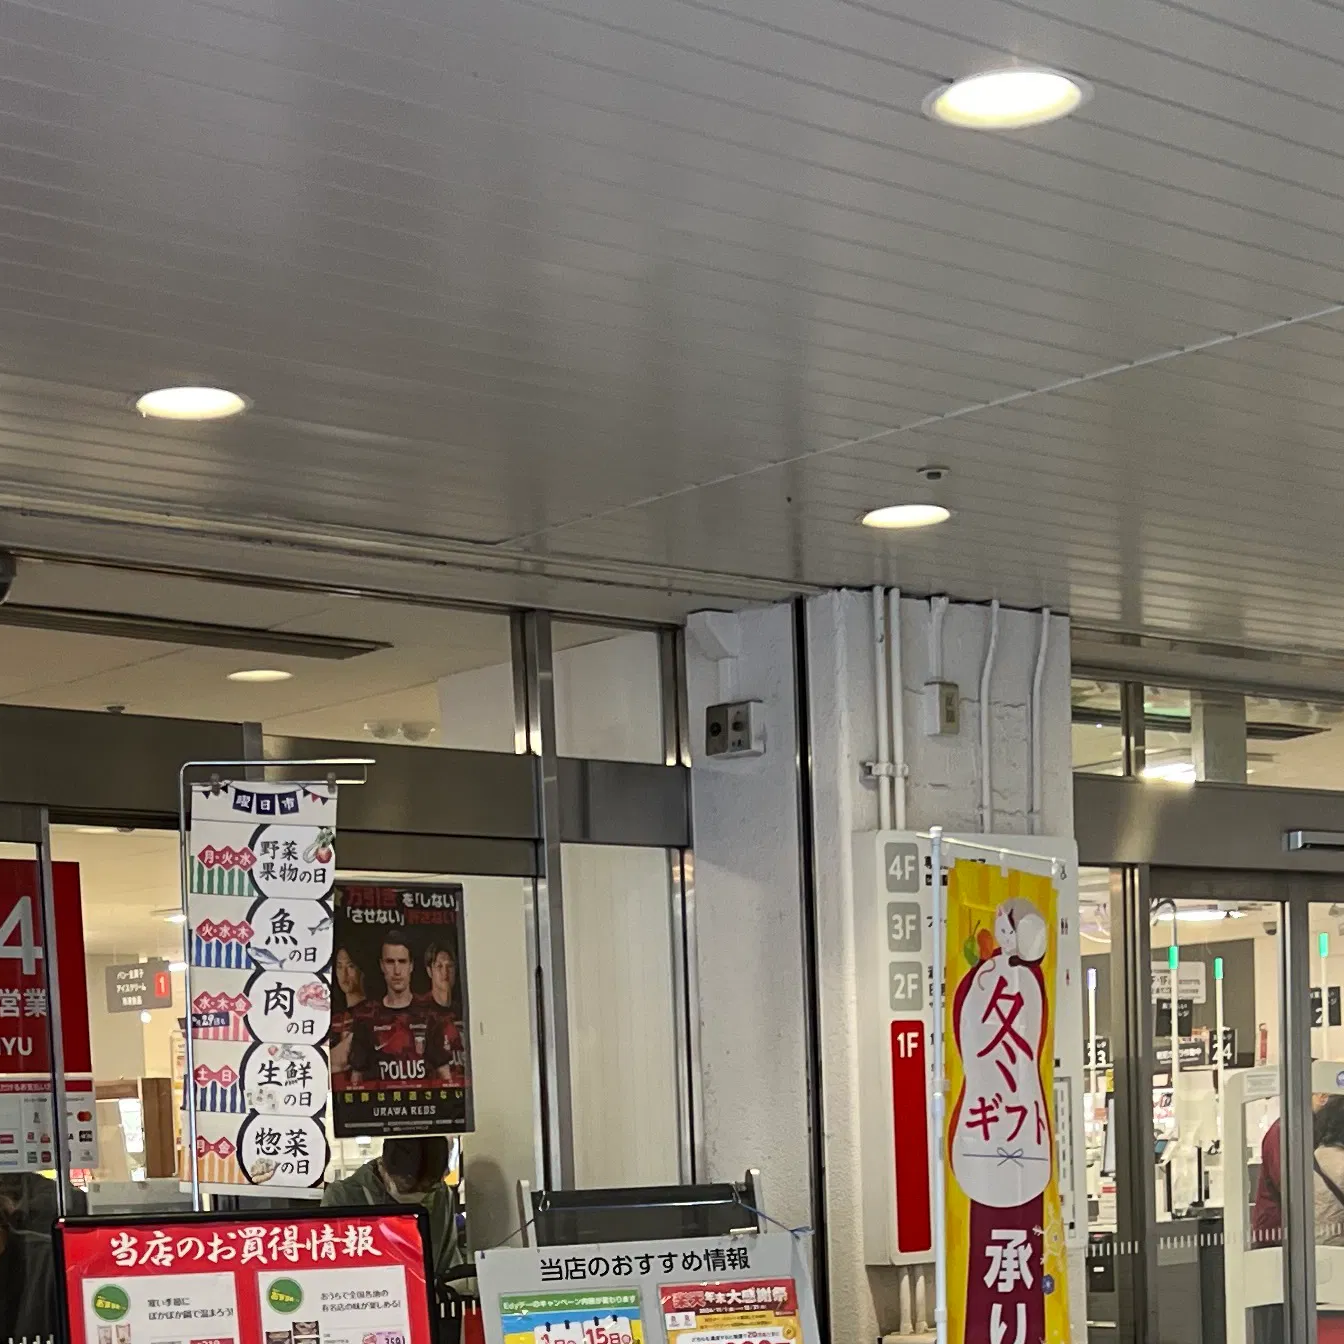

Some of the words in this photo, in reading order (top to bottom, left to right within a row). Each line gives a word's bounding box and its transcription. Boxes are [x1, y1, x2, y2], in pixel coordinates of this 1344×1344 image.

[235, 795, 296, 812] 曜日市
[259, 840, 299, 861] 野菜
[259, 861, 327, 884] 果物の日
[888, 855, 916, 881] 4F
[264, 907, 298, 946] 魚
[891, 913, 917, 941] 3F
[288, 946, 318, 962] の日
[894, 972, 919, 1000] 2F
[263, 981, 296, 1019] 肉
[286, 1019, 315, 1035] の日
[977, 975, 1034, 1093] 冬
[897, 1032, 919, 1058] 1F
[257, 1060, 313, 1088] 生鮮
[379, 1059, 426, 1080] POLUS
[284, 1092, 313, 1108] の日
[373, 1106, 408, 1117] URAWA
[411, 1105, 436, 1116] REDS
[965, 1092, 1046, 1145] ギフト
[255, 1127, 309, 1158] 惣菜
[281, 1159, 309, 1175] の日
[110, 1222, 383, 1268] 当店のお買得情報
[540, 1246, 751, 1283] 当店のおすすめ情報
